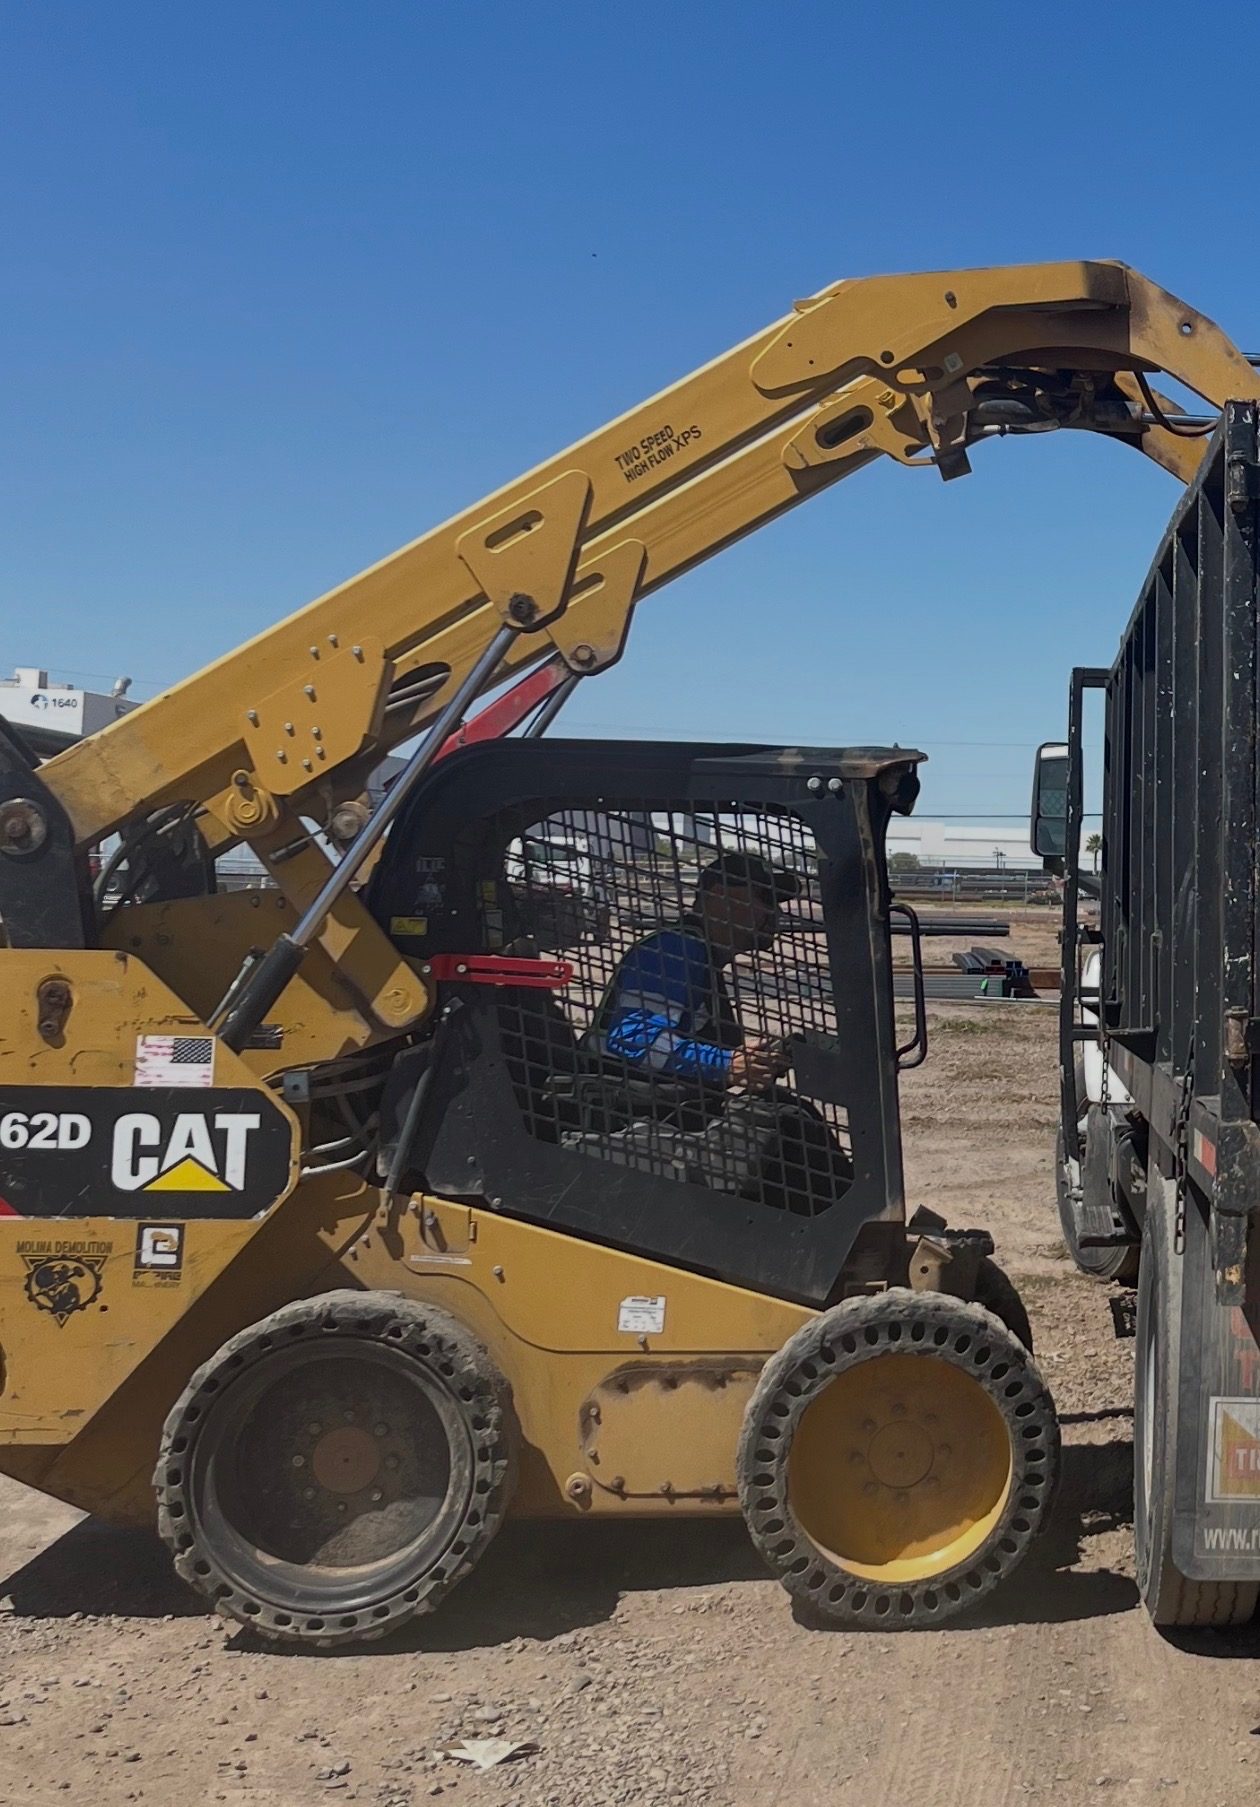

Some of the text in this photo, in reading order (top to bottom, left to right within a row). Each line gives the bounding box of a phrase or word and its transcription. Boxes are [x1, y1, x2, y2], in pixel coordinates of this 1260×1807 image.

[614, 425, 674, 470] TWO SPEED
[624, 425, 702, 483] HIGH FLOW XPS
[52, 698, 78, 708] 1640
[111, 1113, 261, 1191] CAT
[16, 1241, 113, 1254] MOLINA DEMOLITION
[1204, 1528, 1260, 1550] www.r
